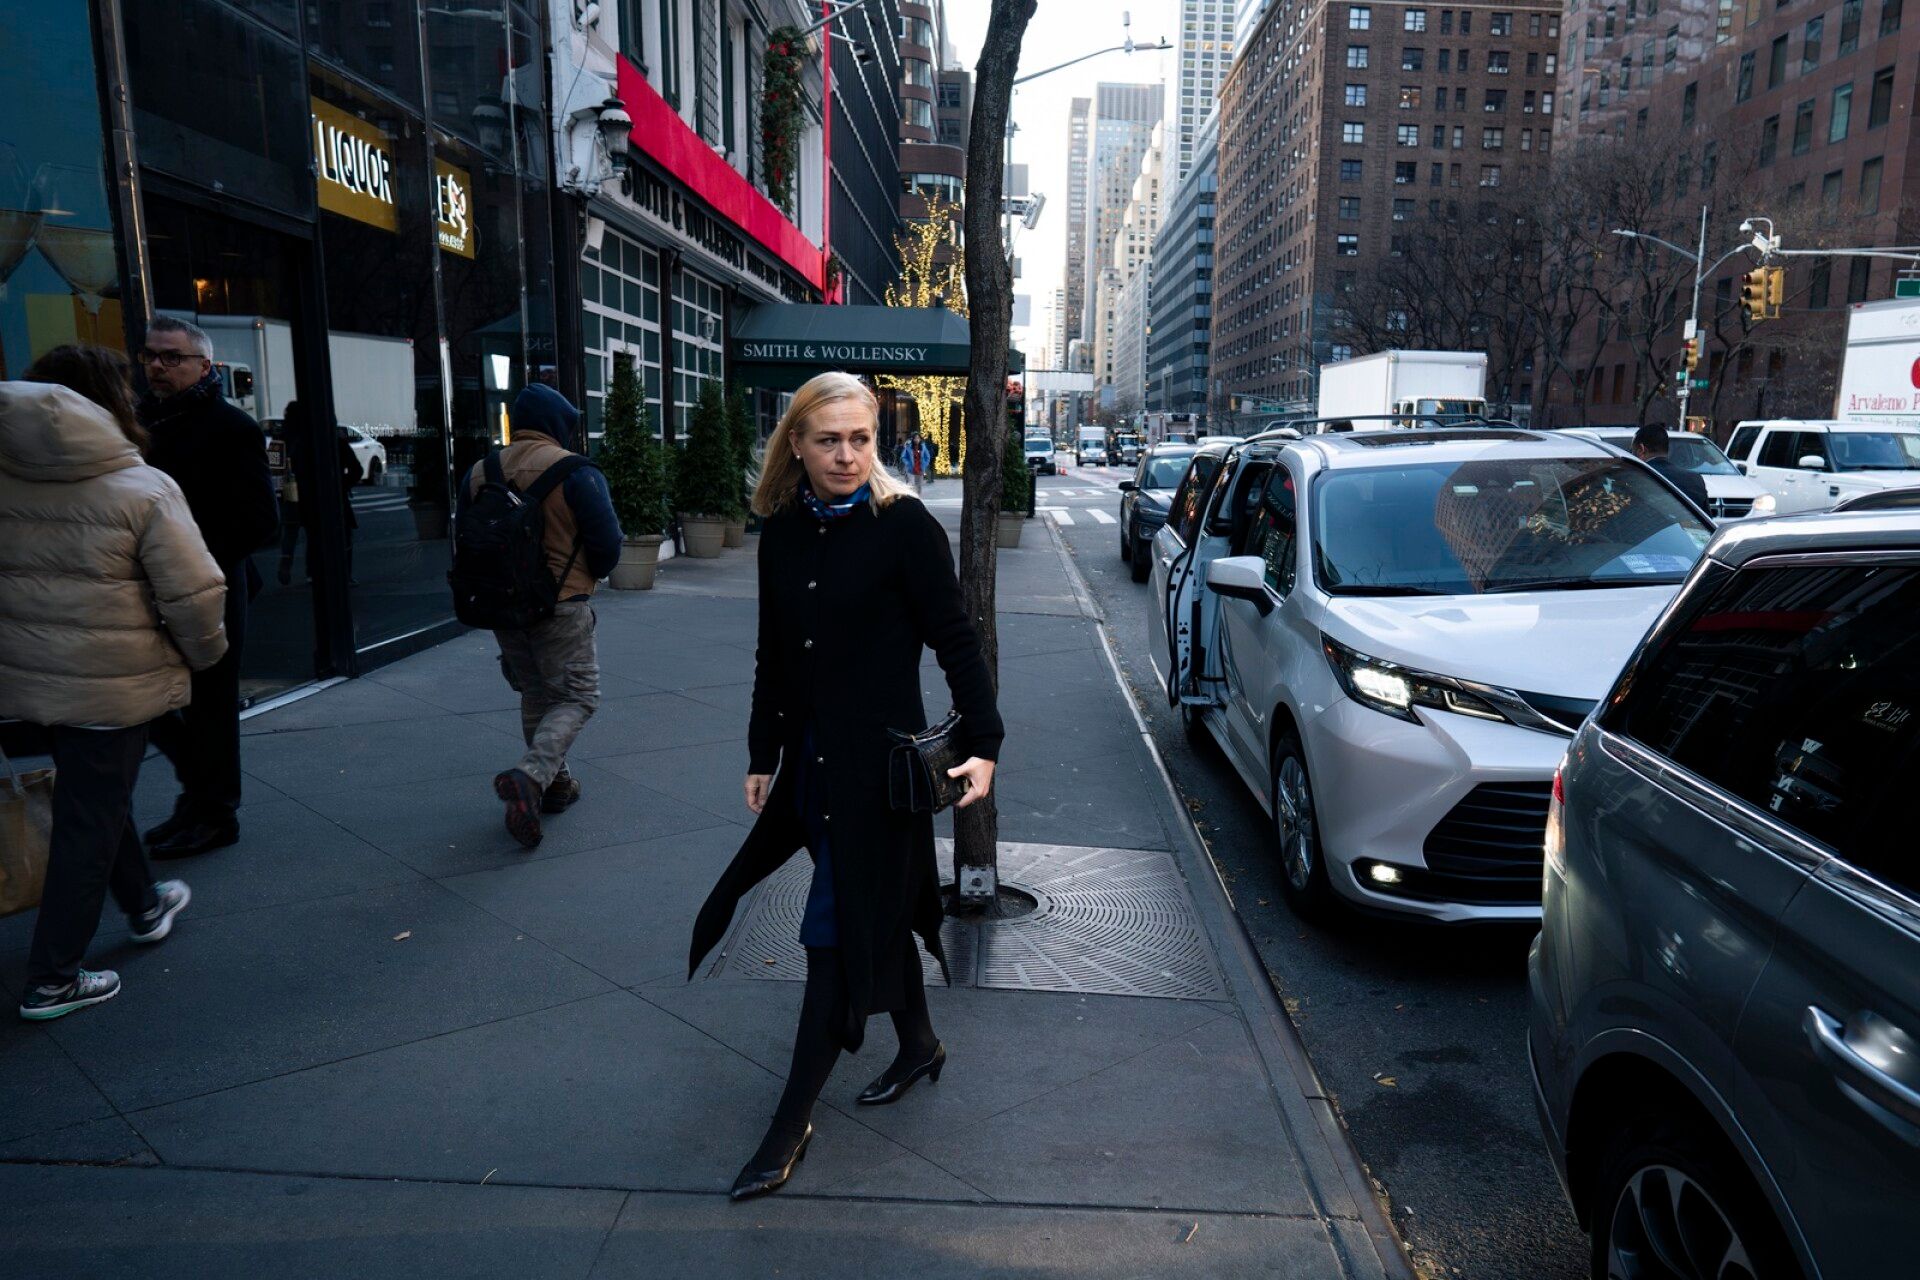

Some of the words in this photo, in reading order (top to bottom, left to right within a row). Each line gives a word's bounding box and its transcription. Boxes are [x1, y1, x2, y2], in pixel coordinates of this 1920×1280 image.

[317, 120, 394, 205] LIQUOR
[622, 162, 671, 224] SMITH
[683, 197, 744, 272] WOLLENSKY
[743, 343, 798, 358] SMITH
[803, 345, 816, 359] &
[821, 345, 928, 361] WOLLENSKY
[1848, 393, 1907, 410] Arvalemo
